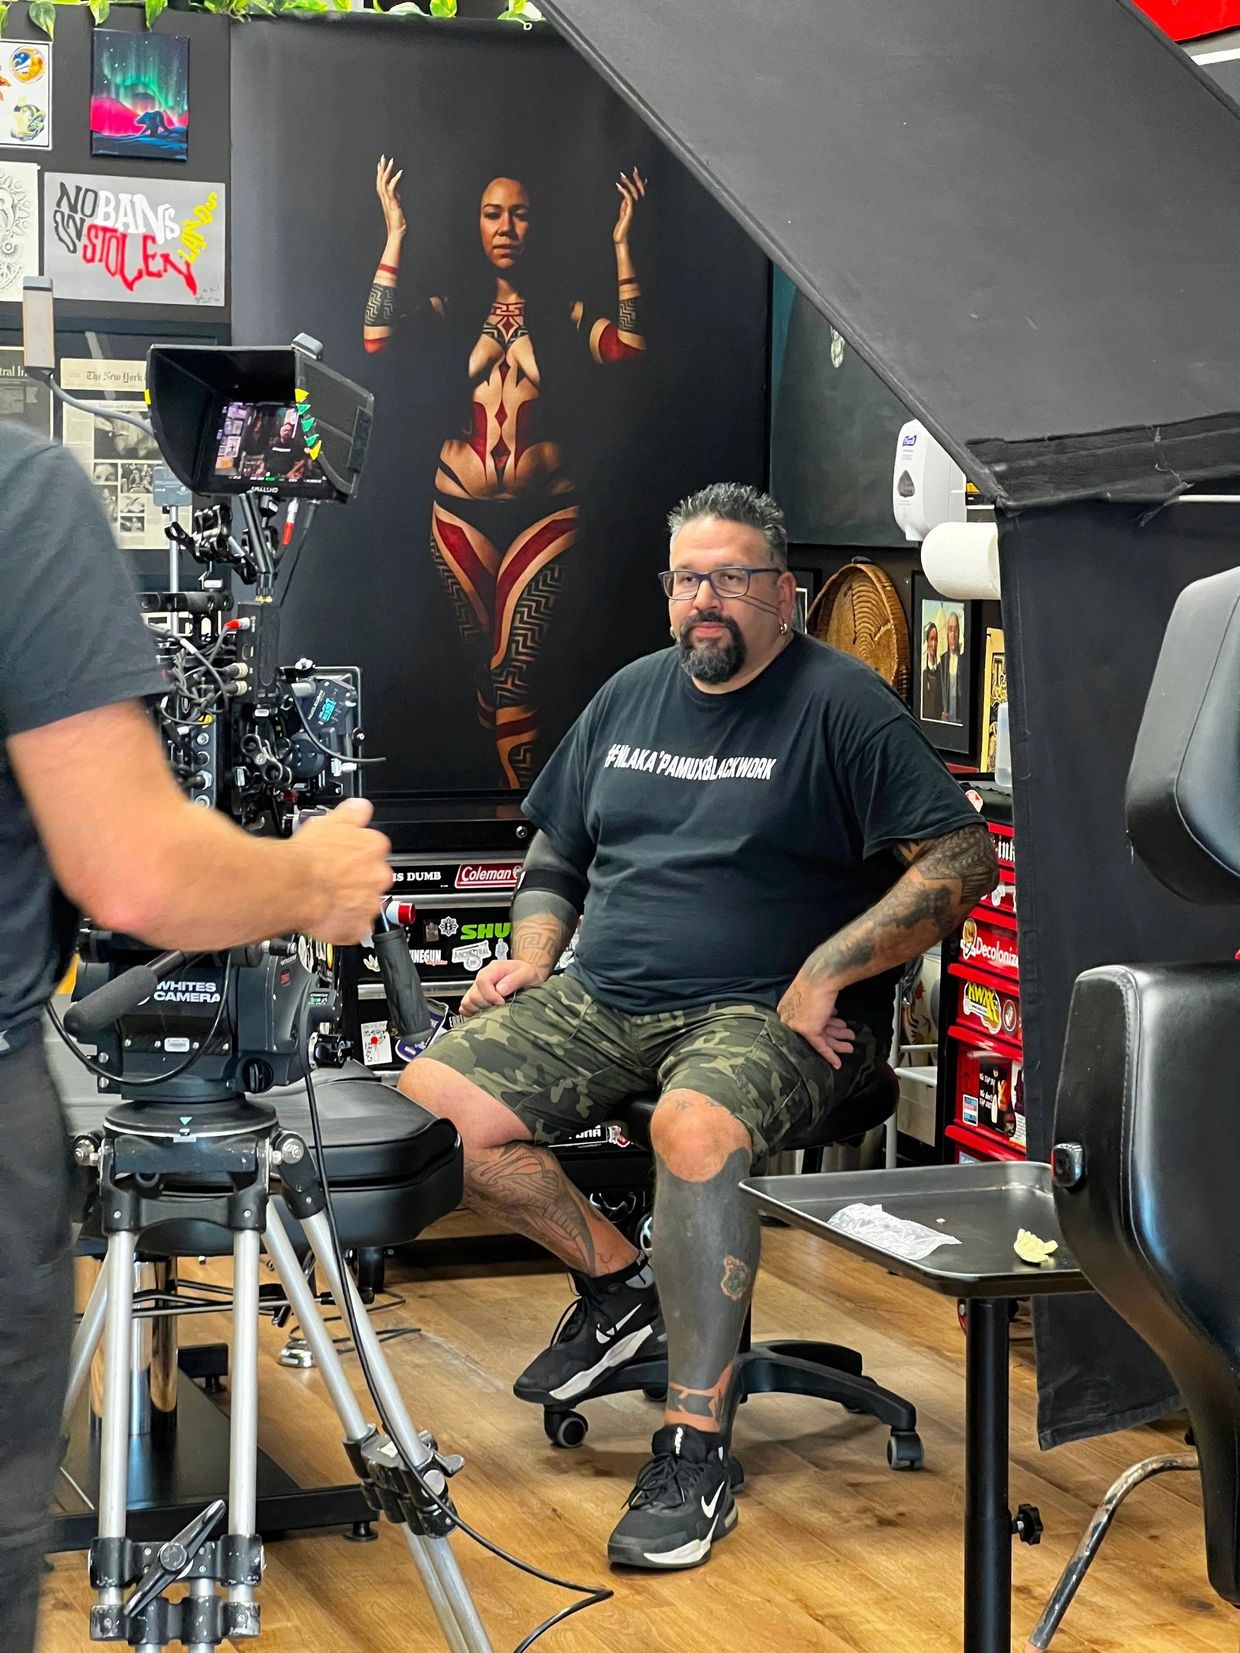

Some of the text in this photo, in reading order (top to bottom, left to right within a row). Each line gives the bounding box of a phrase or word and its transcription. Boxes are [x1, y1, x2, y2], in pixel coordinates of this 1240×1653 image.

[56, 181, 181, 245] NO BANS
[82, 223, 198, 296] STOLEN
[86, 371, 143, 384] The New York
[406, 871, 442, 882] DUMB
[461, 866, 511, 882] Coleman
[156, 981, 217, 992] WHITES
[153, 990, 221, 1003] CAMERA
